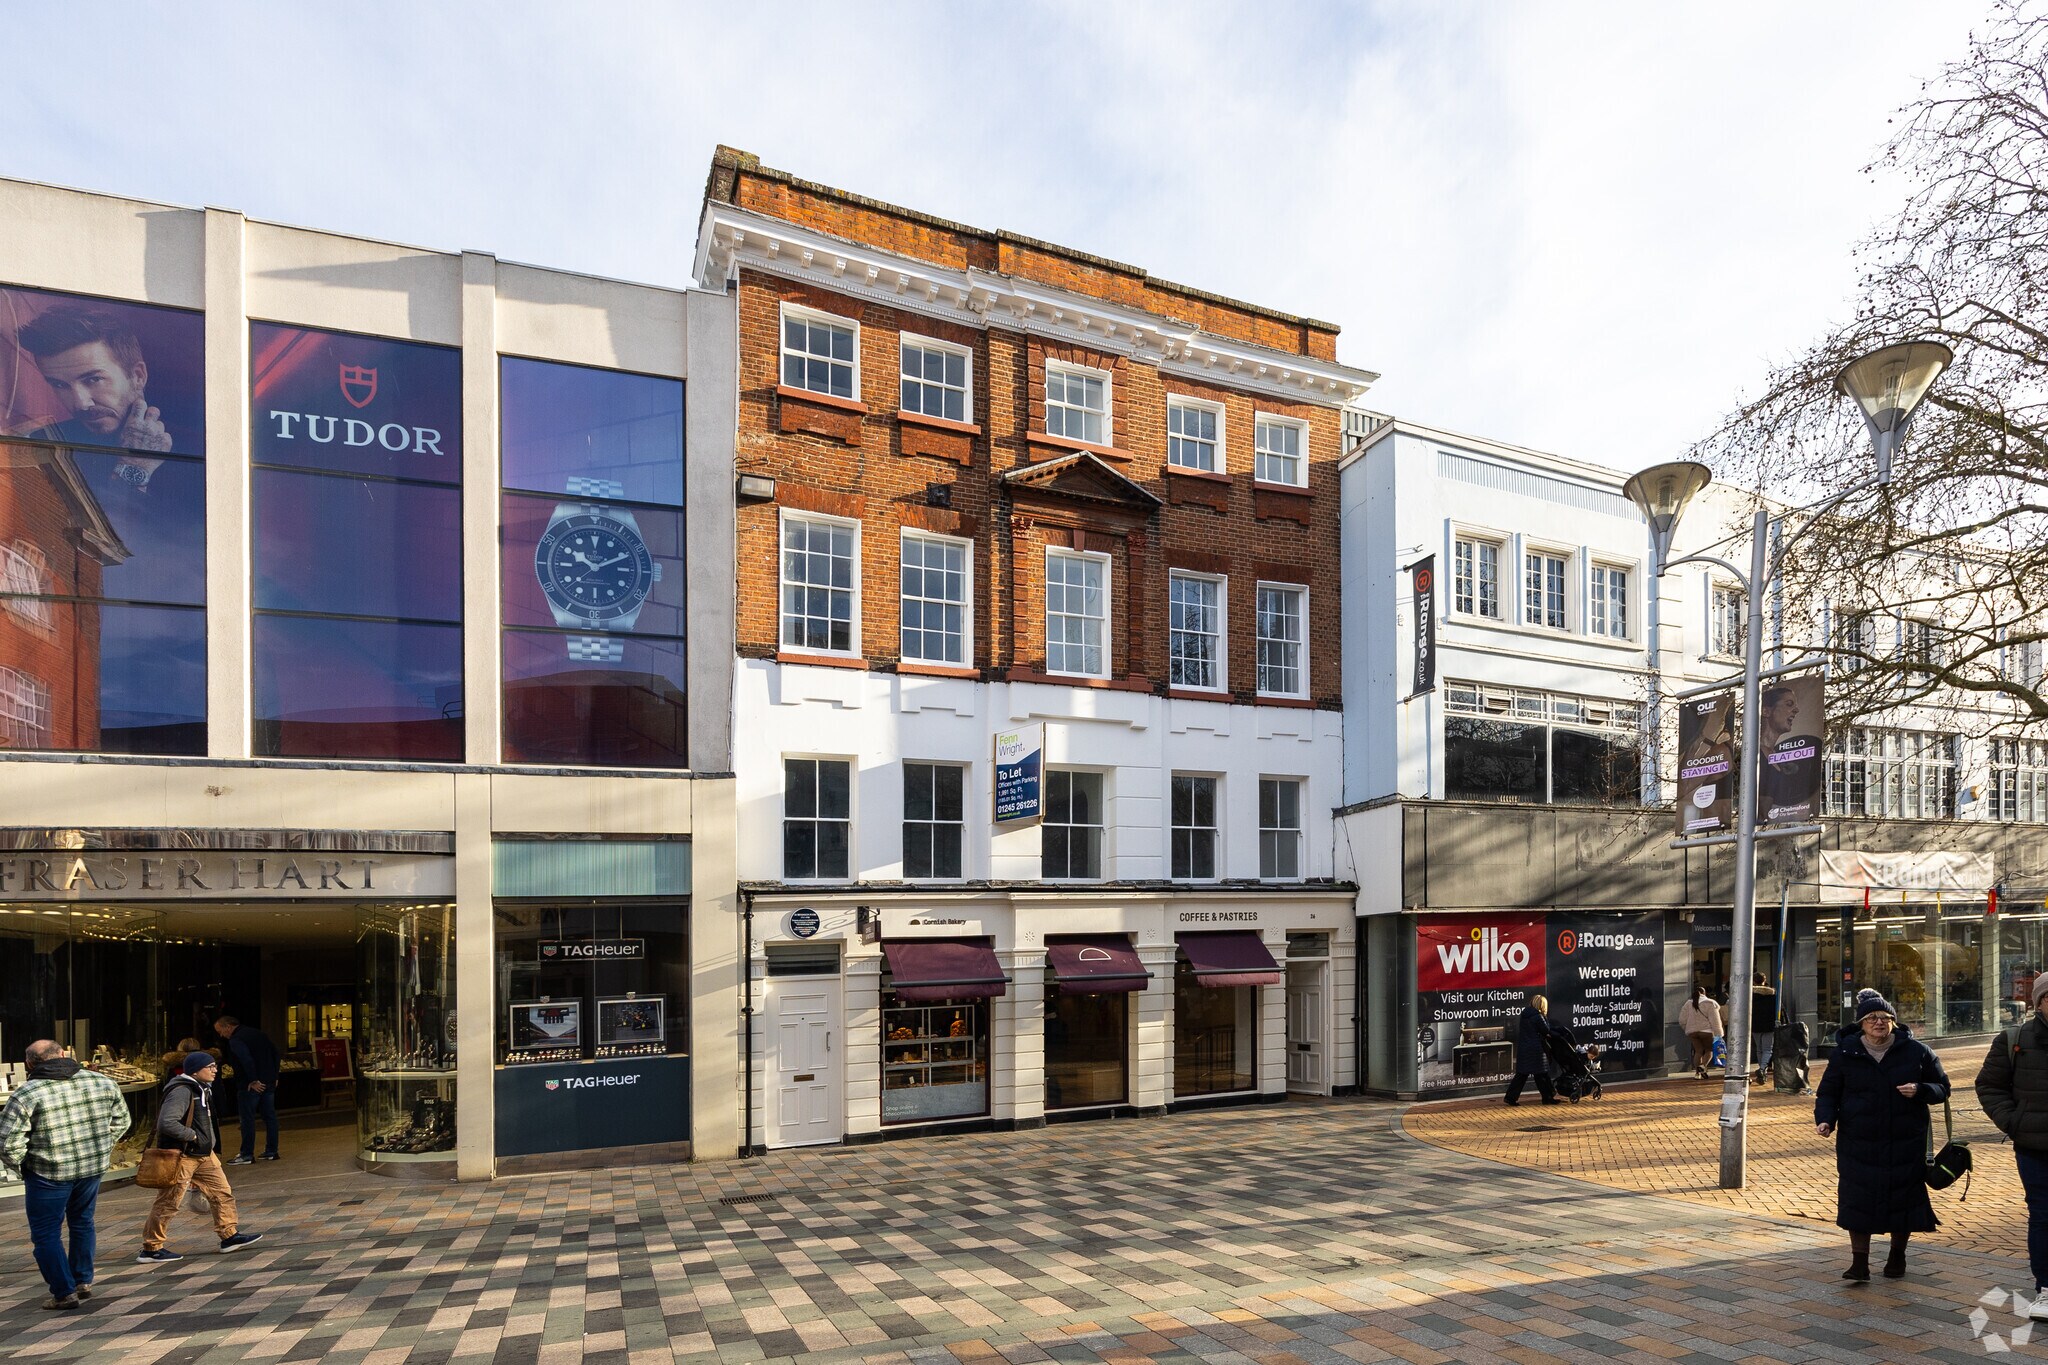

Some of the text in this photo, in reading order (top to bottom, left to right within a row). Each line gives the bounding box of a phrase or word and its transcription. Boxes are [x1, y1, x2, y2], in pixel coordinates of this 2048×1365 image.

[270, 410, 444, 456] TUDOR
[1697, 701, 1717, 712] our
[999, 734, 1018, 746] Fenn
[1779, 739, 1806, 751] HELLO
[1686, 753, 1725, 767] GOODBYE
[1768, 748, 1815, 763] FLAT OUT
[998, 767, 1022, 781] To Let
[1682, 763, 1729, 778] STAYING IN
[1022, 776, 1038, 784] Parking
[998, 799, 1038, 814] 01245 261226
[1780, 803, 1810, 813] Chelmsford
[0, 857, 384, 892] FRASER HART
[948, 918, 967, 926] Bakery
[1179, 911, 1258, 922] COFFEE & PASTRIES
[1694, 924, 1716, 932] Welcome
[1583, 932, 1655, 951] Range.co.uk
[1437, 927, 1530, 974] wilko
[1579, 966, 1637, 980] We're open
[1441, 990, 1525, 1004] Visit our Kitchen
[1585, 984, 1631, 998] until late
[1433, 1005, 1526, 1021] Showroom in-stor
[1572, 1003, 1603, 1014] Monday
[1609, 1000, 1642, 1012] Saturday
[1572, 1016, 1604, 1027] 9.00am
[1611, 1013, 1642, 1026] 8.00pm
[1594, 1028, 1622, 1040] Sunday
[1614, 1040, 1645, 1052] 4.30pm
[1420, 1079, 1435, 1088] Free
[1437, 1077, 1456, 1087] Home
[1457, 1074, 1485, 1085] Measure
[1486, 1073, 1499, 1082] and
